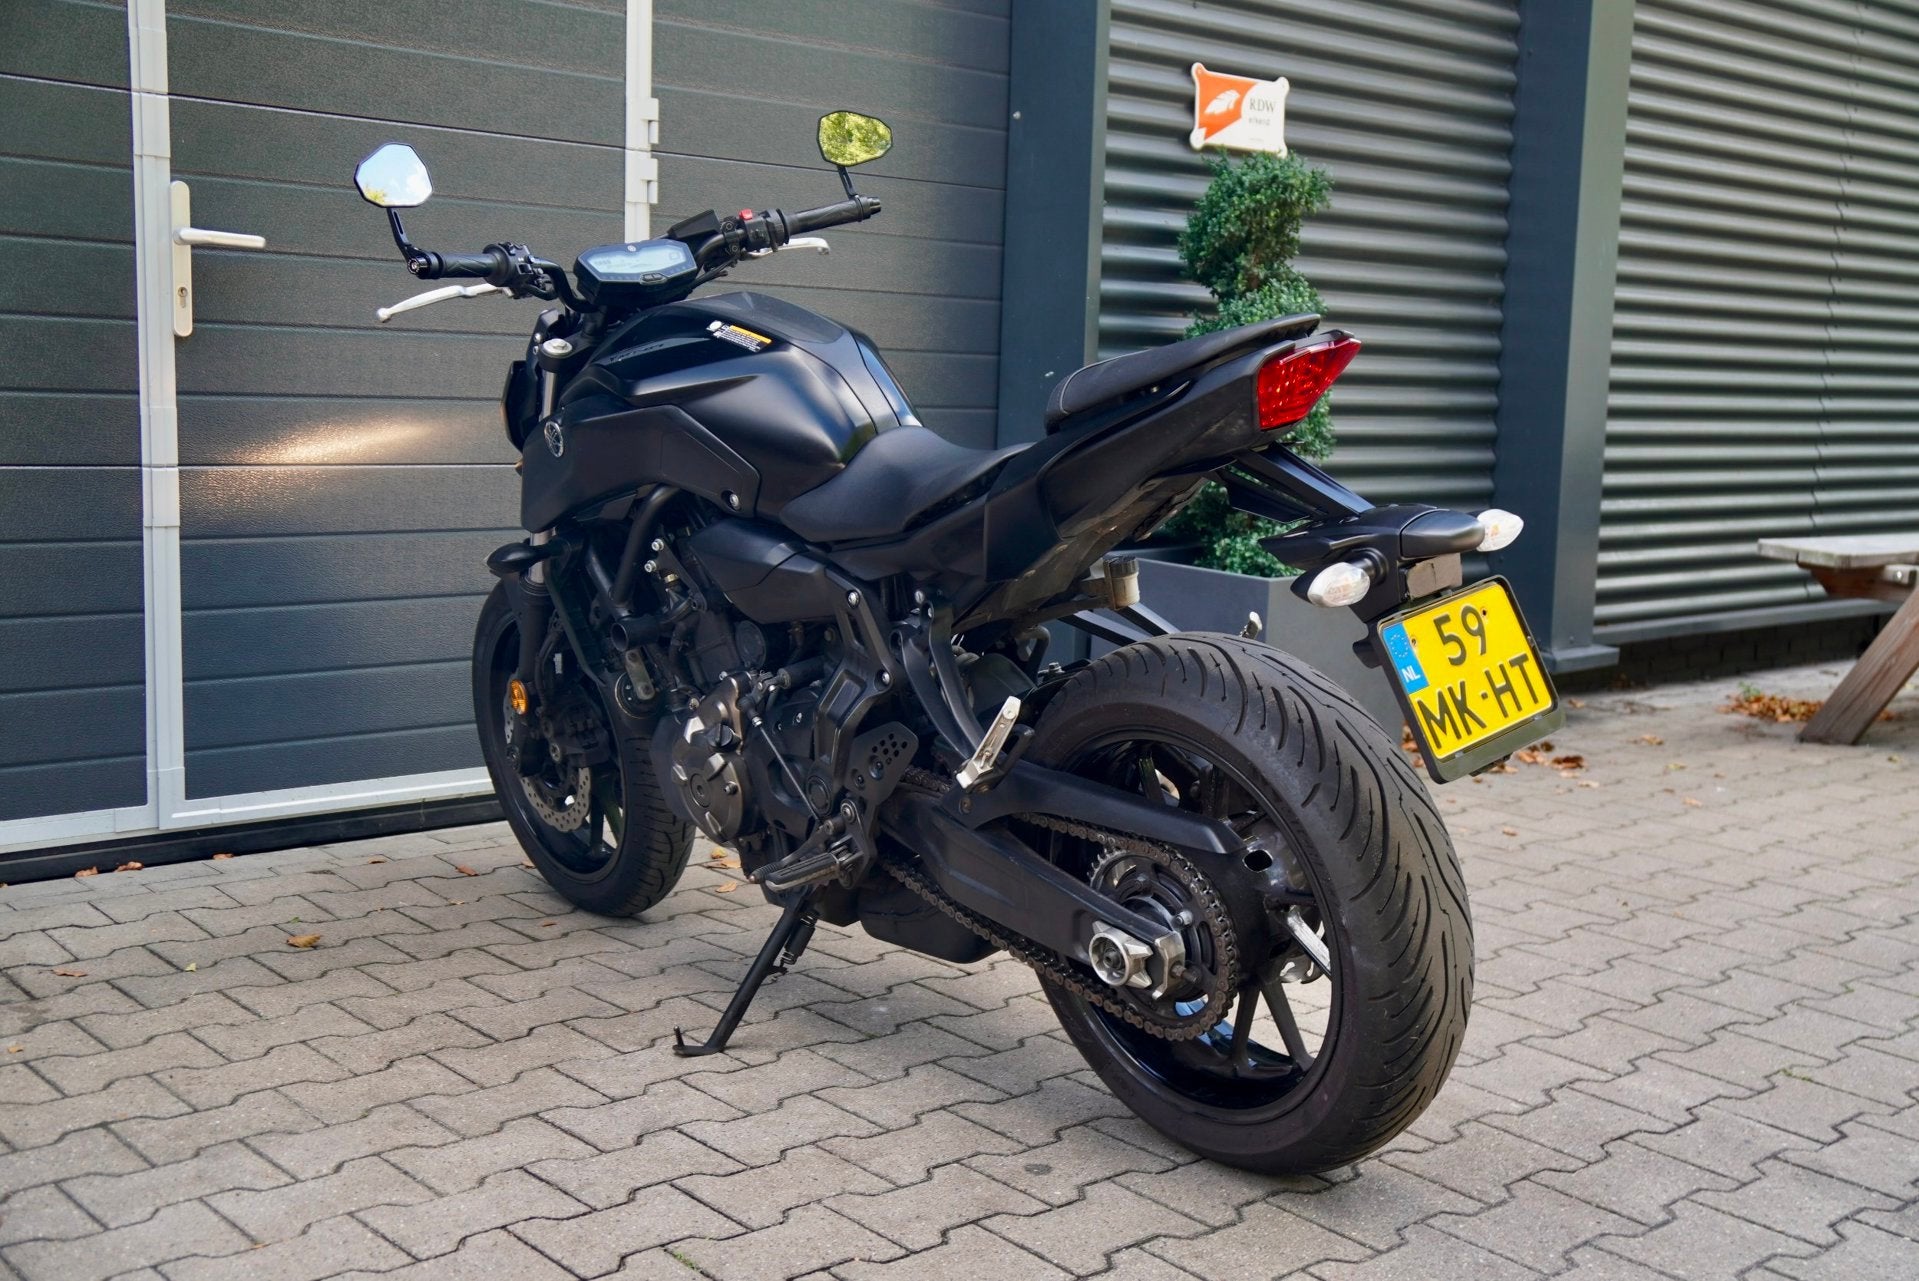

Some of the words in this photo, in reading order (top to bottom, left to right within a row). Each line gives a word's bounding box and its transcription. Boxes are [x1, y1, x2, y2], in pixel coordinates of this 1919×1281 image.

[1249, 97, 1276, 113] RDW
[1433, 605, 1487, 667] 59
[1401, 665, 1422, 683] NL
